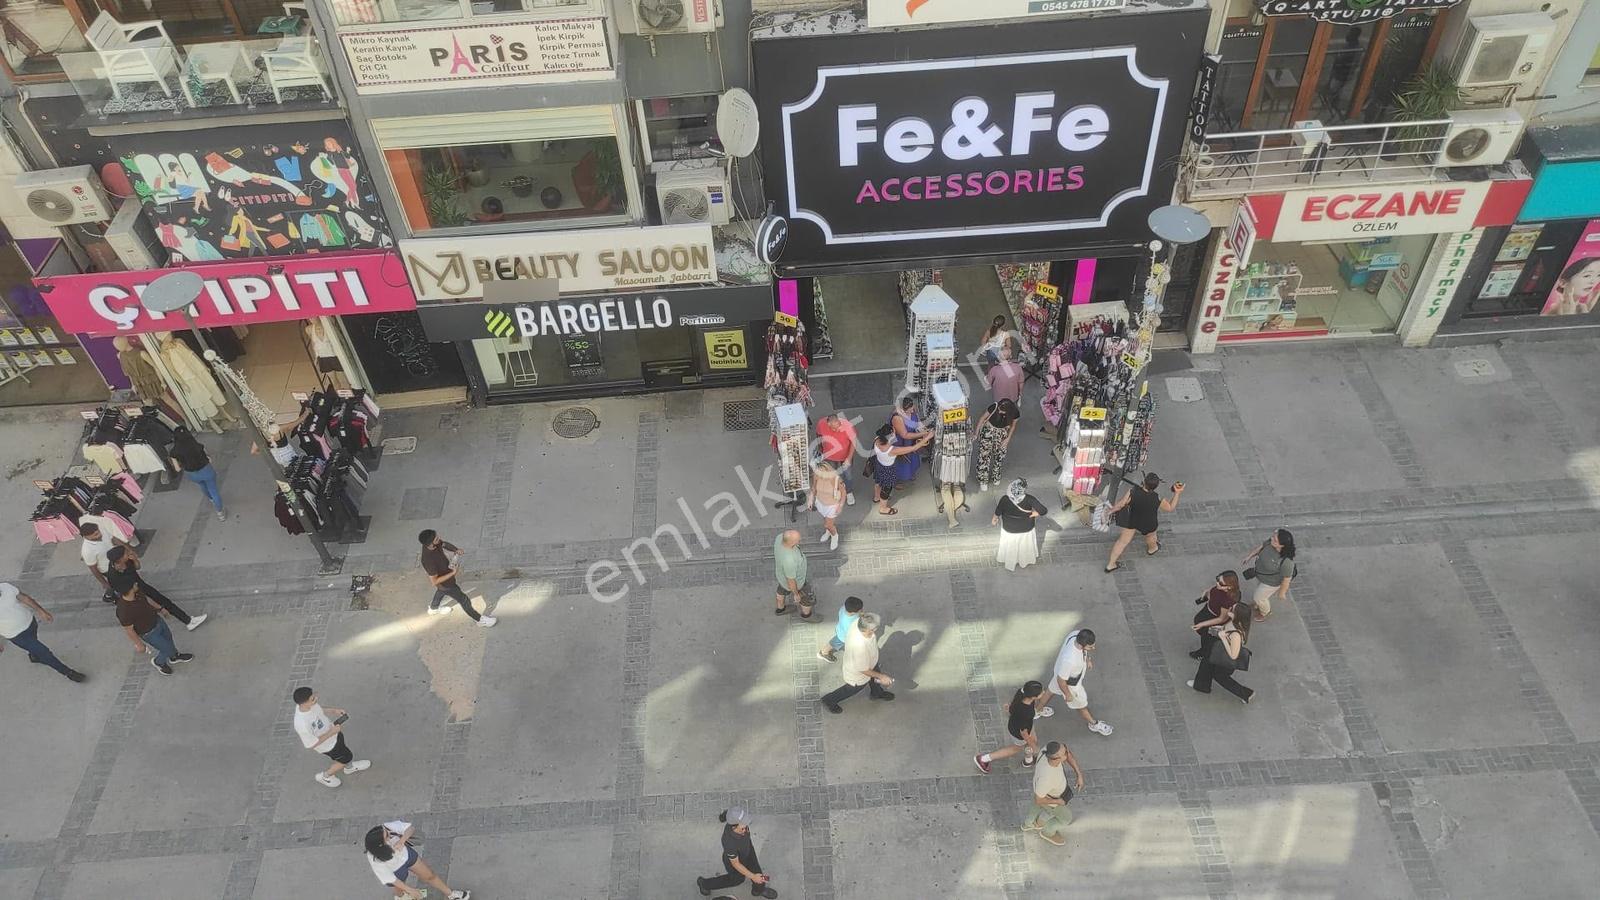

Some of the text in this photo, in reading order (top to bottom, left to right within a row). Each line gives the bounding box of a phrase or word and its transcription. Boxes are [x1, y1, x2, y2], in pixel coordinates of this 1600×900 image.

[1042, 3, 1068, 11] 0545
[1070, 0, 1089, 9] 478
[1274, 0, 1339, 12] Q-ART
[1320, 8, 1394, 19] STUDIO
[561, 22, 595, 31] Makyaj
[349, 35, 411, 45] Mikro Kaynak
[558, 32, 585, 41] Kirpik
[352, 44, 417, 54] Keratin Kaynak
[539, 43, 566, 51] Kirpik
[356, 53, 407, 63] Saç Botoks
[541, 52, 570, 60] Protez
[481, 62, 530, 74] Coiffeur
[1193, 66, 1214, 136] TATTOO
[838, 91, 1110, 167] Fe&Fe
[856, 165, 1085, 204] ACCESSORIES
[1301, 188, 1466, 222] ECZANE
[1352, 221, 1399, 233] ÖZLEM
[472, 245, 710, 284] BEAUTY SALOON
[614, 275, 665, 287] Masoumeh
[1427, 233, 1473, 318] Pharmacy
[1038, 285, 1054, 295] 100
[88, 270, 370, 330] ÇIIPITI
[515, 297, 726, 338] BARGELLO Perfume
[944, 411, 963, 420] 120
